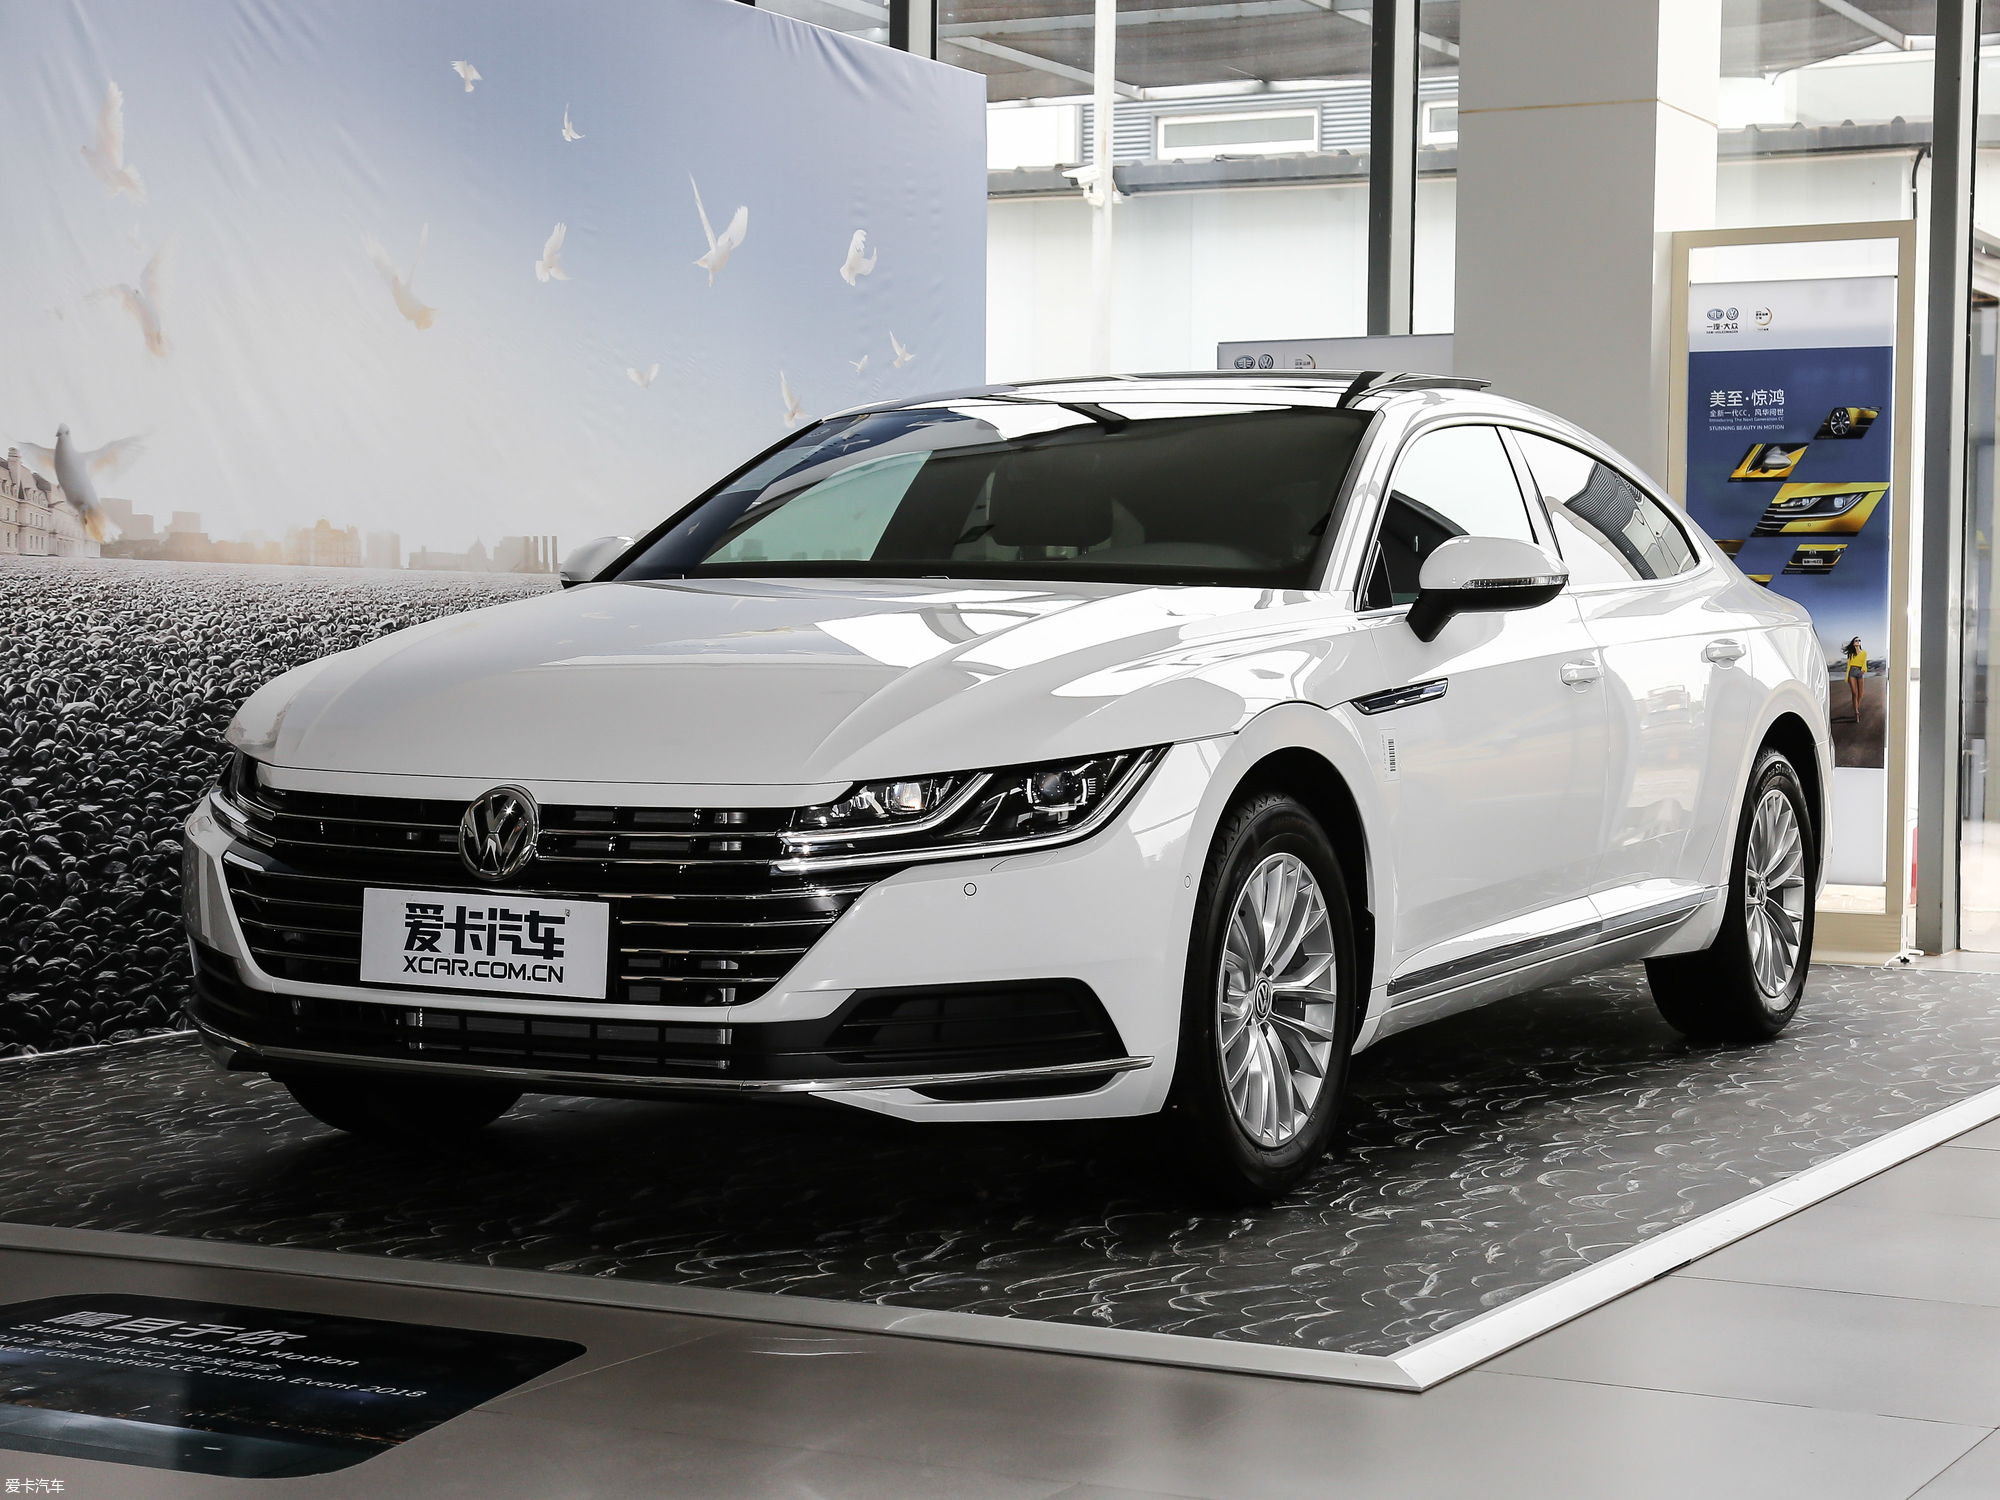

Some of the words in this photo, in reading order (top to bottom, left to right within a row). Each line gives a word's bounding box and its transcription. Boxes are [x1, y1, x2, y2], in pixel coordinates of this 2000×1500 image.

[1710, 389, 1785, 407] 美至·惊鸿
[404, 902, 566, 961] 爱卡汽车
[402, 955, 564, 984] XCAR.COM.CN
[10, 1323, 131, 1342] Stunning
[131, 1336, 230, 1353] Beauty
[229, 1347, 258, 1355] in
[260, 1350, 360, 1367] Motion
[43, 1310, 307, 1346] 瞩目于你
[45, 1351, 166, 1369] Generation
[169, 1364, 205, 1372] CC
[203, 1367, 286, 1382] Launch
[288, 1377, 358, 1390] Event
[359, 1385, 428, 1398] 2018
